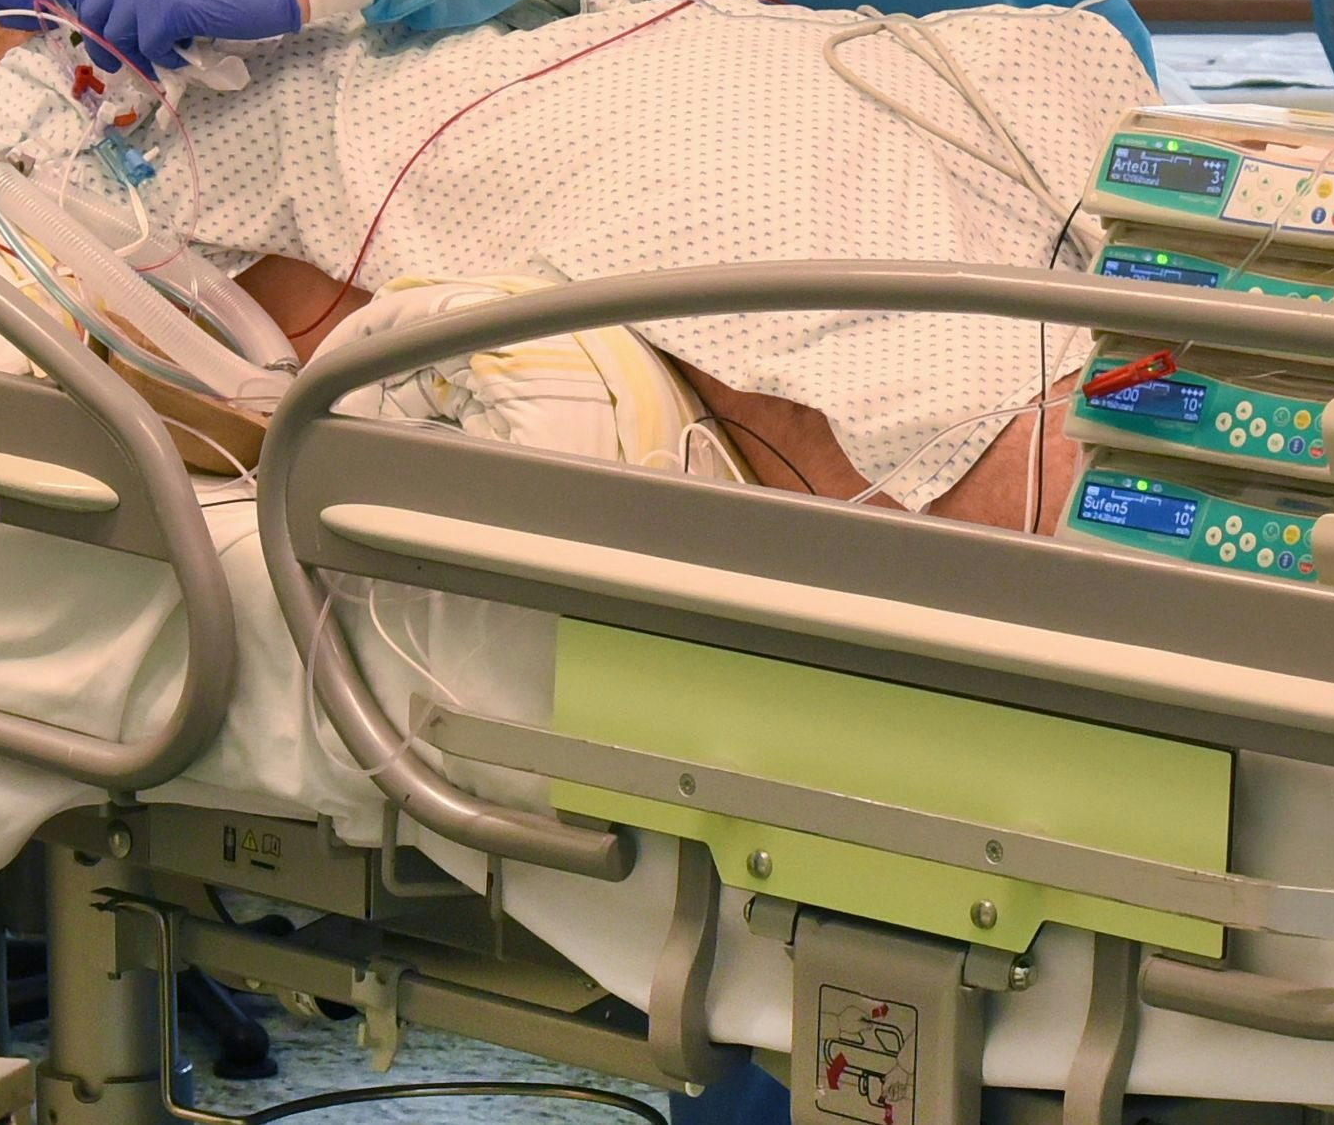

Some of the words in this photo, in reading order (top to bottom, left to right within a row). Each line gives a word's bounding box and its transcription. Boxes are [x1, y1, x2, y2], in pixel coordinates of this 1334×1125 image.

[1211, 171, 1220, 185] 3
[1083, 495, 1129, 515] Sufen5
[1175, 511, 1190, 526] 10
